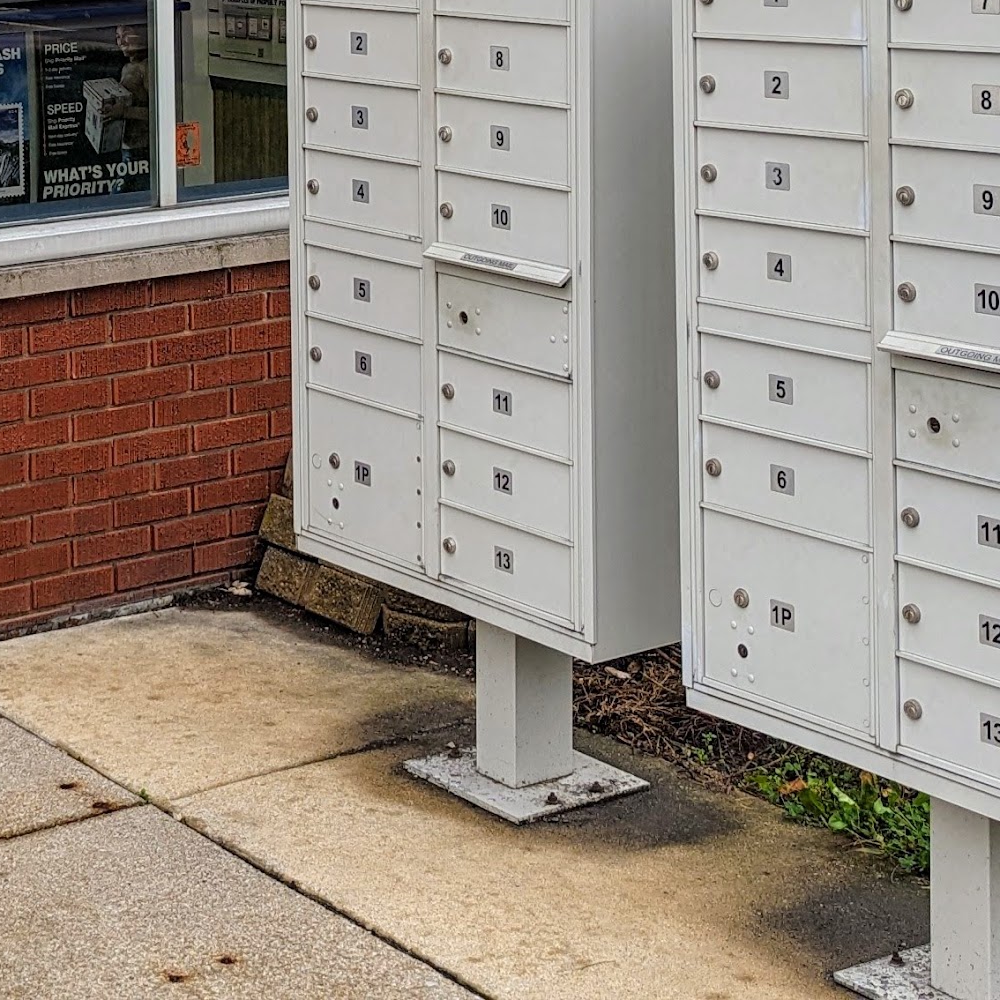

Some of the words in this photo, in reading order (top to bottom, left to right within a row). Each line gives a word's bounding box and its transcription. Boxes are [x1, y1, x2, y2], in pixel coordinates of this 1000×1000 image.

[45, 42, 78, 55] PRICE
[355, 36, 363, 52] 2
[495, 51, 503, 68] 8
[772, 76, 781, 94] 2
[47, 101, 83, 115] SPEED
[980, 91, 991, 110] 8
[356, 110, 364, 126] 3
[496, 130, 504, 147] 9
[44, 164, 103, 184] WHAT'S
[106, 160, 149, 179] YOUR
[773, 168, 782, 186] 3
[43, 178, 125, 200] PRIORITY?
[356, 184, 365, 200] 4
[982, 191, 994, 210] 9
[493, 209, 508, 226] 10
[774, 259, 784, 277] 4
[358, 283, 366, 298] 5
[977, 289, 1000, 311] 10
[940, 346, 992, 361] OUTGOING
[359, 356, 367, 371] 6
[776, 381, 786, 399] 5
[495, 394, 508, 412] 11
[355, 466, 369, 483] 1P
[495, 473, 510, 491] 12
[777, 471, 787, 489] 6
[981, 521, 1000, 544] 11
[496, 551, 510, 569] 13
[772, 605, 792, 625] 1P
[982, 621, 1000, 644] 12
